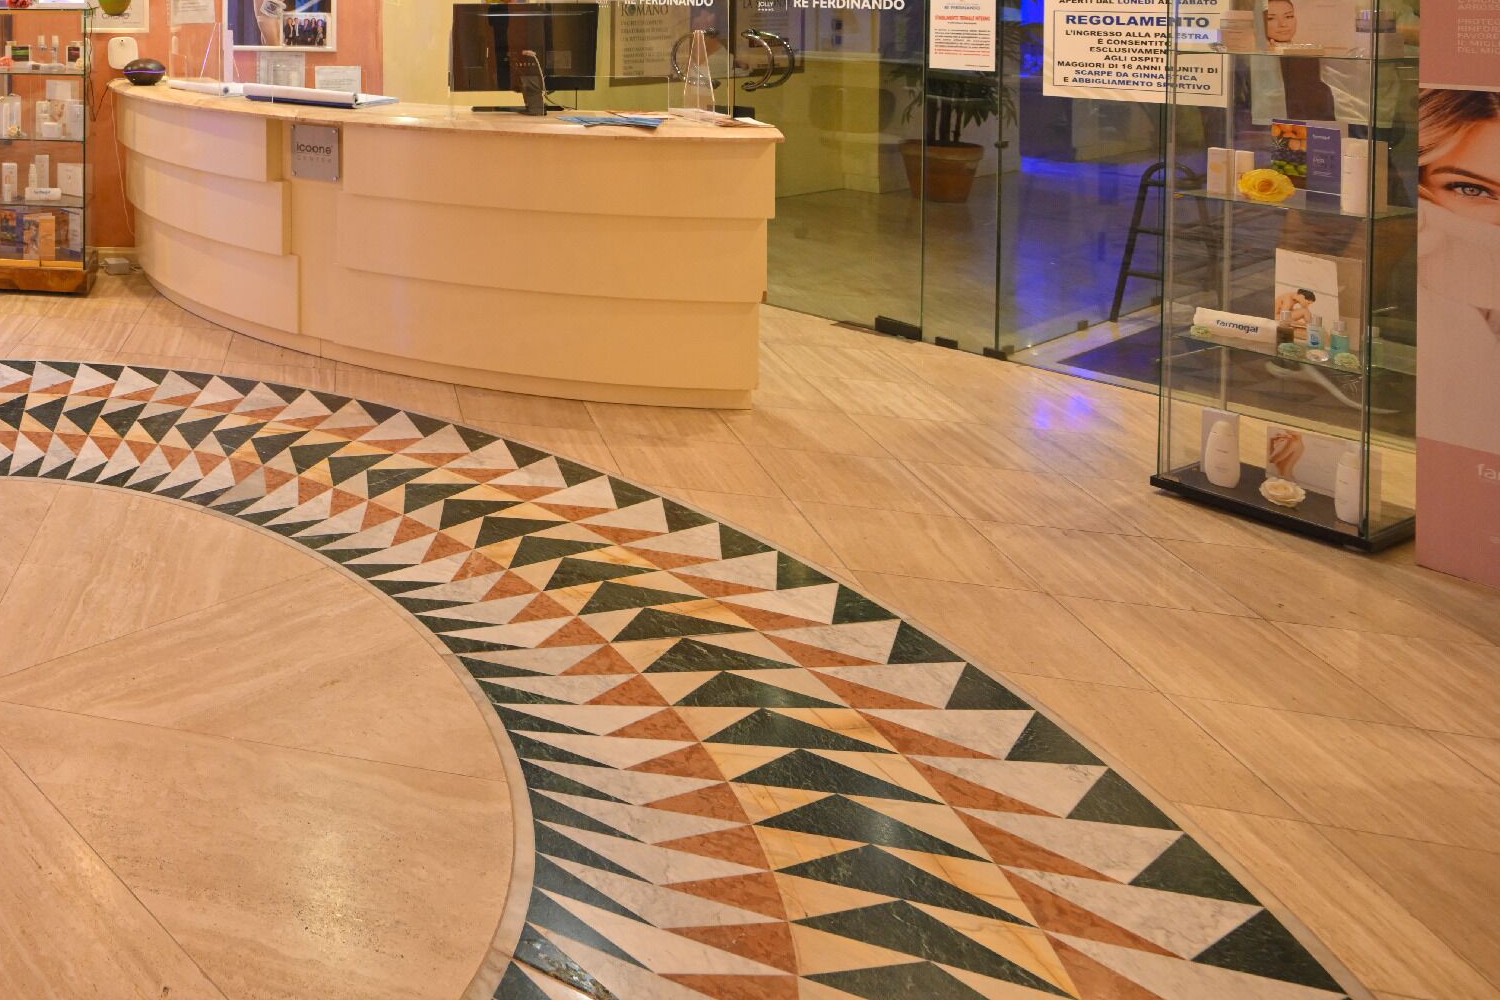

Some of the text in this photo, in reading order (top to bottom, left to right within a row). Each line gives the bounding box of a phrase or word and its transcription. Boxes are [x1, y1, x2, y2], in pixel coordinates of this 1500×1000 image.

[1065, 15, 1210, 28] REGOLAMENTO
[1065, 29, 1122, 37] L'INGRESSO
[1154, 32, 1210, 40] PALESTRA
[1106, 39, 1172, 47] CONSENTITO
[1103, 54, 1127, 62] AGLI
[1057, 60, 1105, 69] MAGGIORI
[1074, 69, 1113, 77] SCARPE
[1071, 77, 1154, 88] ABBIGLIAMENTO
[1216, 318, 1259, 334] farmogal
